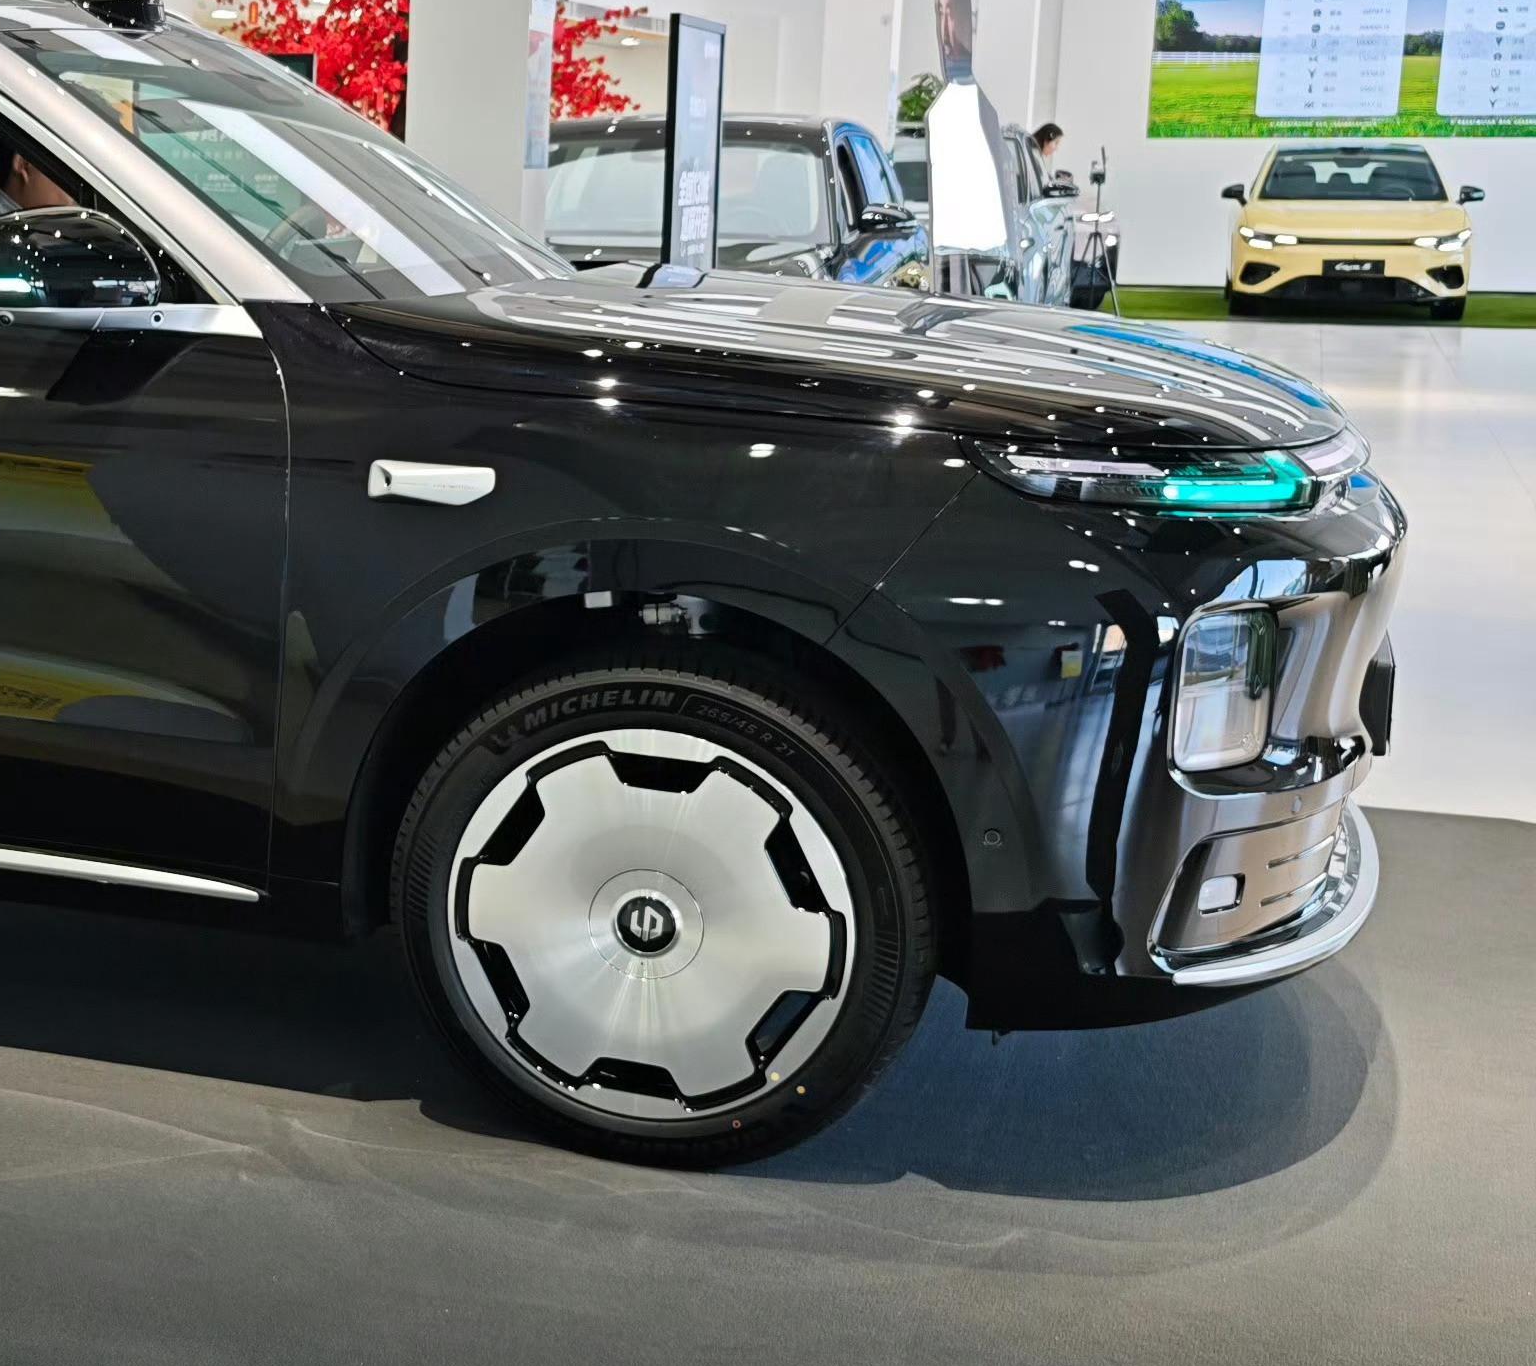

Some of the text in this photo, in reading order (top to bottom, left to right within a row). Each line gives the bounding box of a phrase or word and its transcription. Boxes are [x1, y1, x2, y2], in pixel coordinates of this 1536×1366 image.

[524, 689, 675, 730] MICHELIN
[696, 704, 758, 735] 265/45
[775, 742, 797, 757] 21
